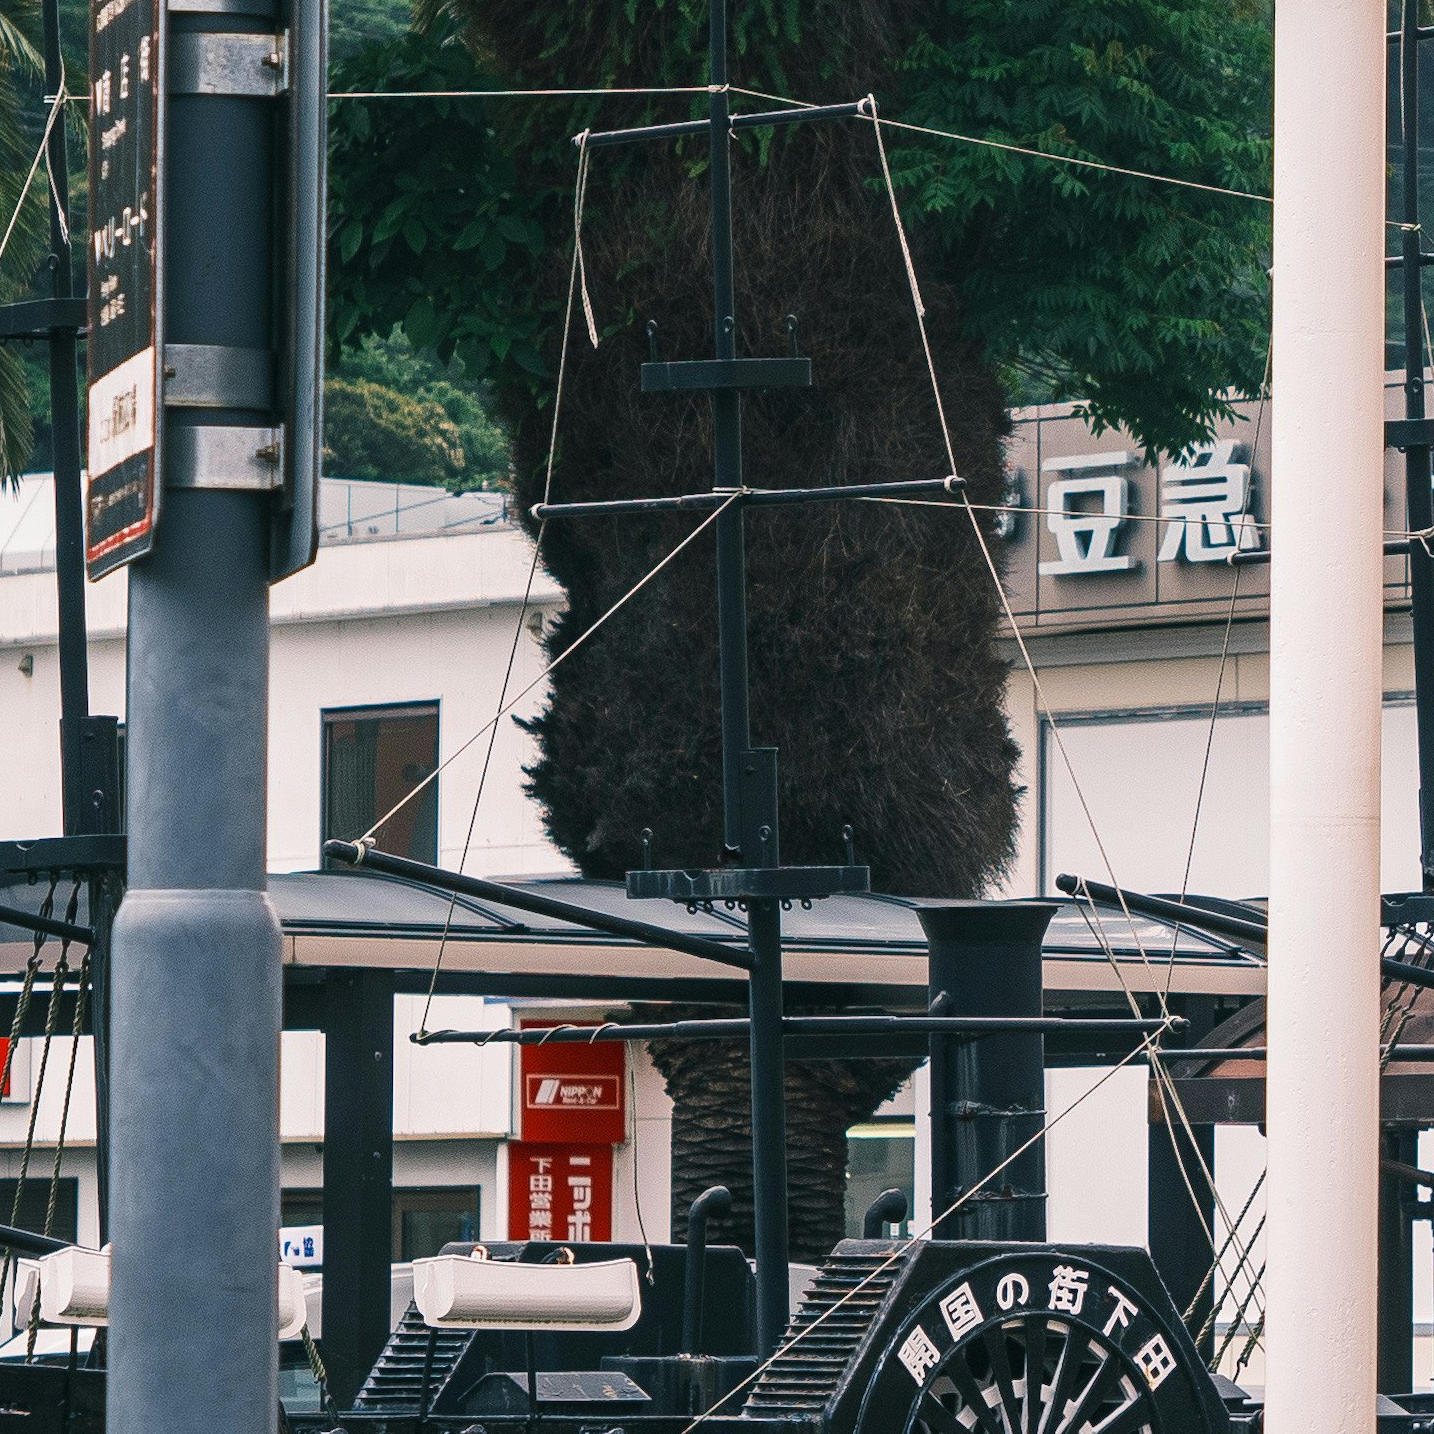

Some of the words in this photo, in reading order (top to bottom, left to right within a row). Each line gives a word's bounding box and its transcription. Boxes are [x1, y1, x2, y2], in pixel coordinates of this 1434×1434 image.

[897, 1265, 1178, 1392] 開国の街下田
